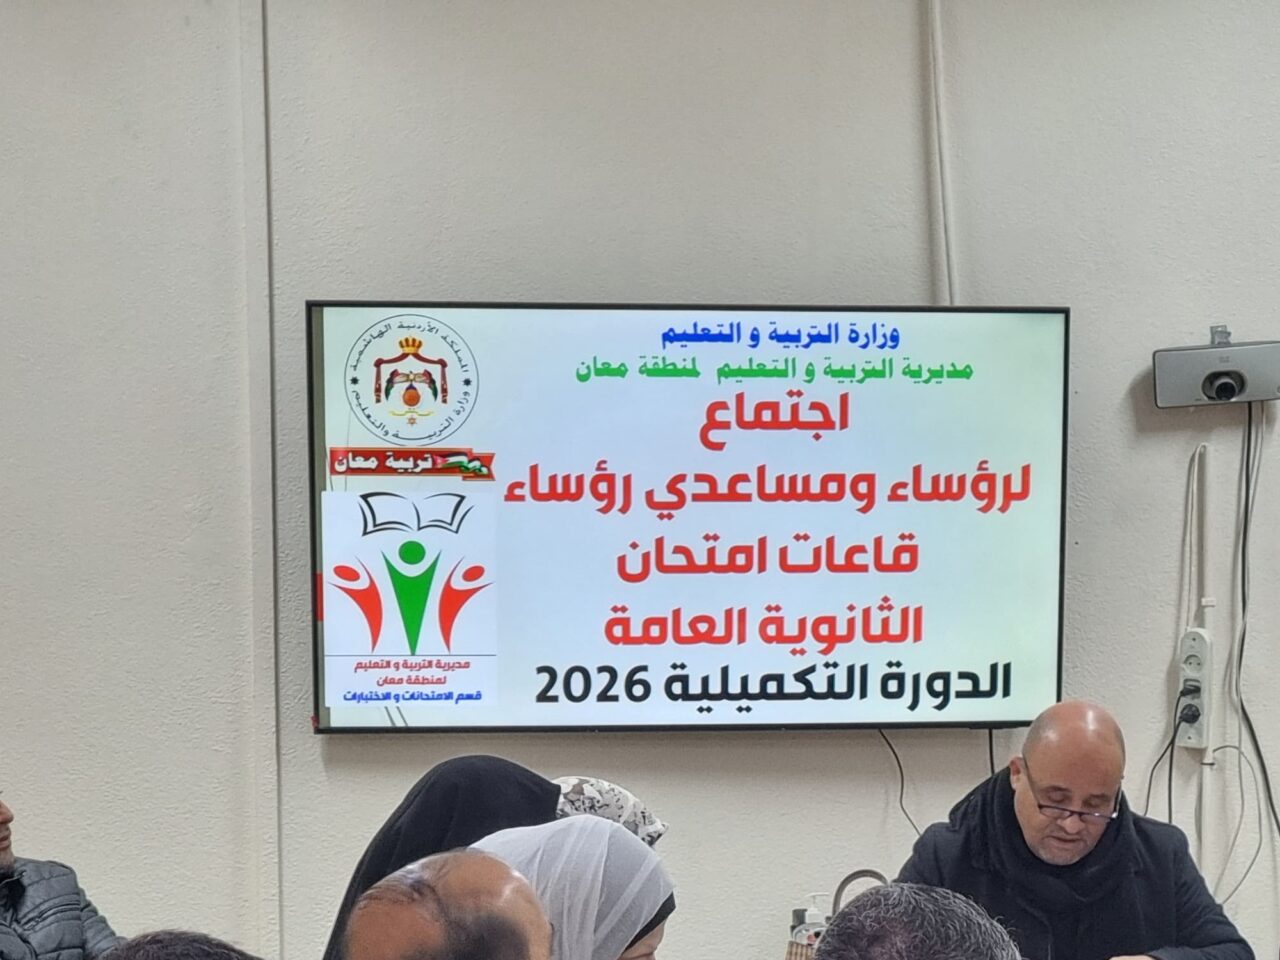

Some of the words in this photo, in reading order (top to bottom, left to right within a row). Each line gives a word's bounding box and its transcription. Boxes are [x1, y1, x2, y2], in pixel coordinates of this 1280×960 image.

[661, 321, 741, 349] التعليم
[747, 330, 760, 348] و
[768, 322, 838, 349] التربية
[848, 322, 900, 349] وزارة
[575, 357, 629, 383] معان
[638, 355, 701, 379] لمنطقة
[716, 357, 796, 385] التعليم
[802, 365, 816, 384] و
[823, 357, 893, 385] التربية
[902, 357, 974, 386] مديرية
[699, 389, 849, 452] اجتماع
[334, 452, 379, 472] معان
[385, 452, 433, 473] تربية
[504, 459, 632, 515] رؤساء
[645, 463, 876, 521] ومساعدي
[887, 460, 1031, 514] لرؤساء
[616, 532, 767, 583] امتحان
[778, 532, 919, 573] قاعات
[604, 604, 747, 645] العامة
[758, 595, 923, 656] الثانوية
[354, 659, 391, 673] التعليم
[402, 659, 433, 671] التربية
[434, 659, 470, 672] مديرية
[376, 676, 404, 687] معان
[405, 674, 447, 685] لمنطقة
[535, 665, 652, 703] 2026
[664, 660, 868, 714] التكميلية
[880, 659, 1012, 712] الدورة
[343, 690, 391, 704] الاختبارات
[402, 690, 453, 701] الامتحانات
[455, 690, 482, 704] قسم
